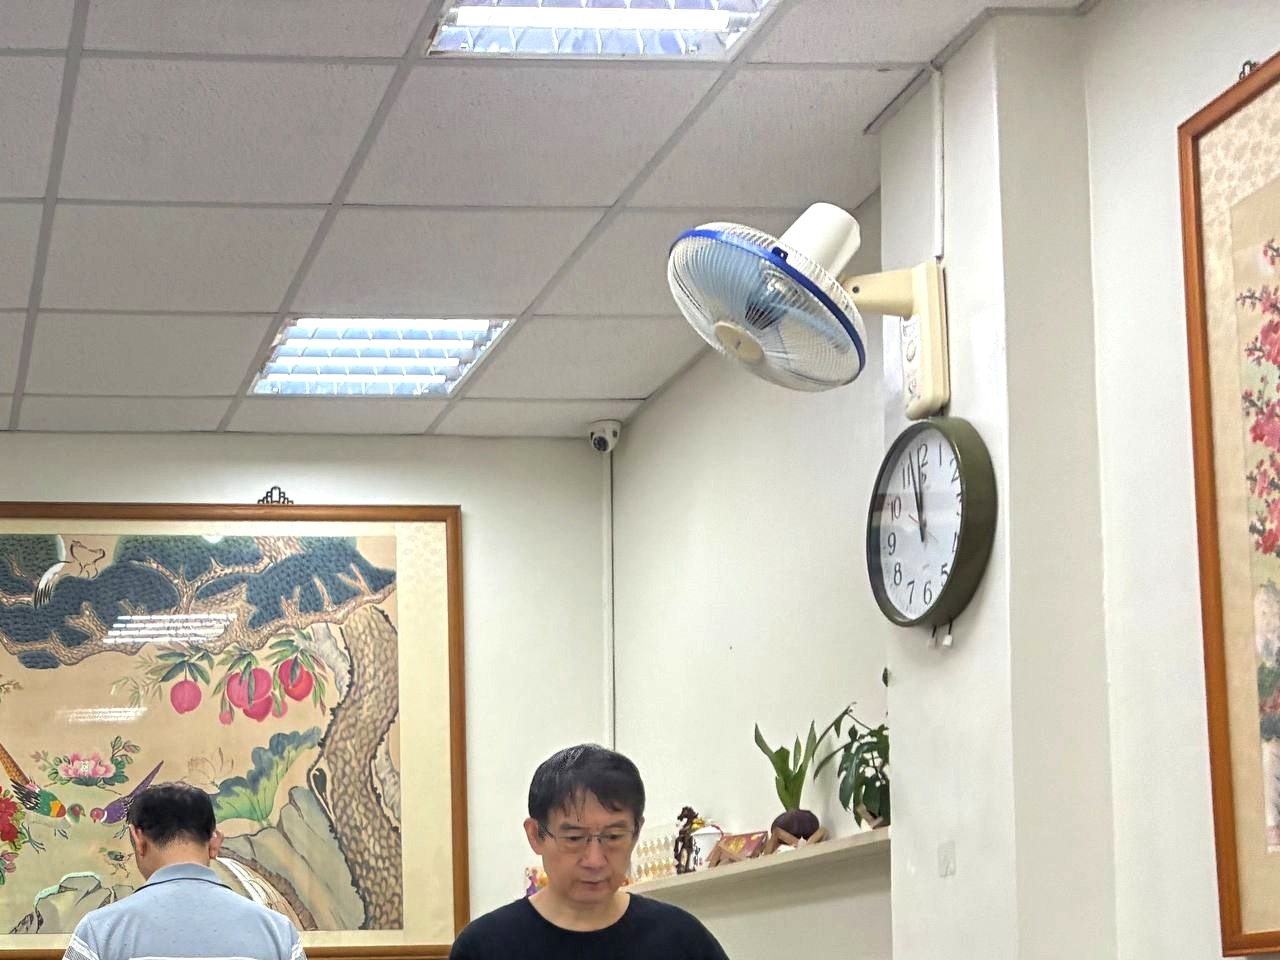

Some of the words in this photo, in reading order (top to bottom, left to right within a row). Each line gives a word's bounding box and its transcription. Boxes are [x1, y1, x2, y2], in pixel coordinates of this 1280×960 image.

[902, 463, 911, 489] 11
[890, 496, 902, 521] 10
[887, 532, 897, 556] 9
[893, 562, 903, 586] 8
[907, 580, 916, 605] 7
[923, 580, 933, 605] 6
